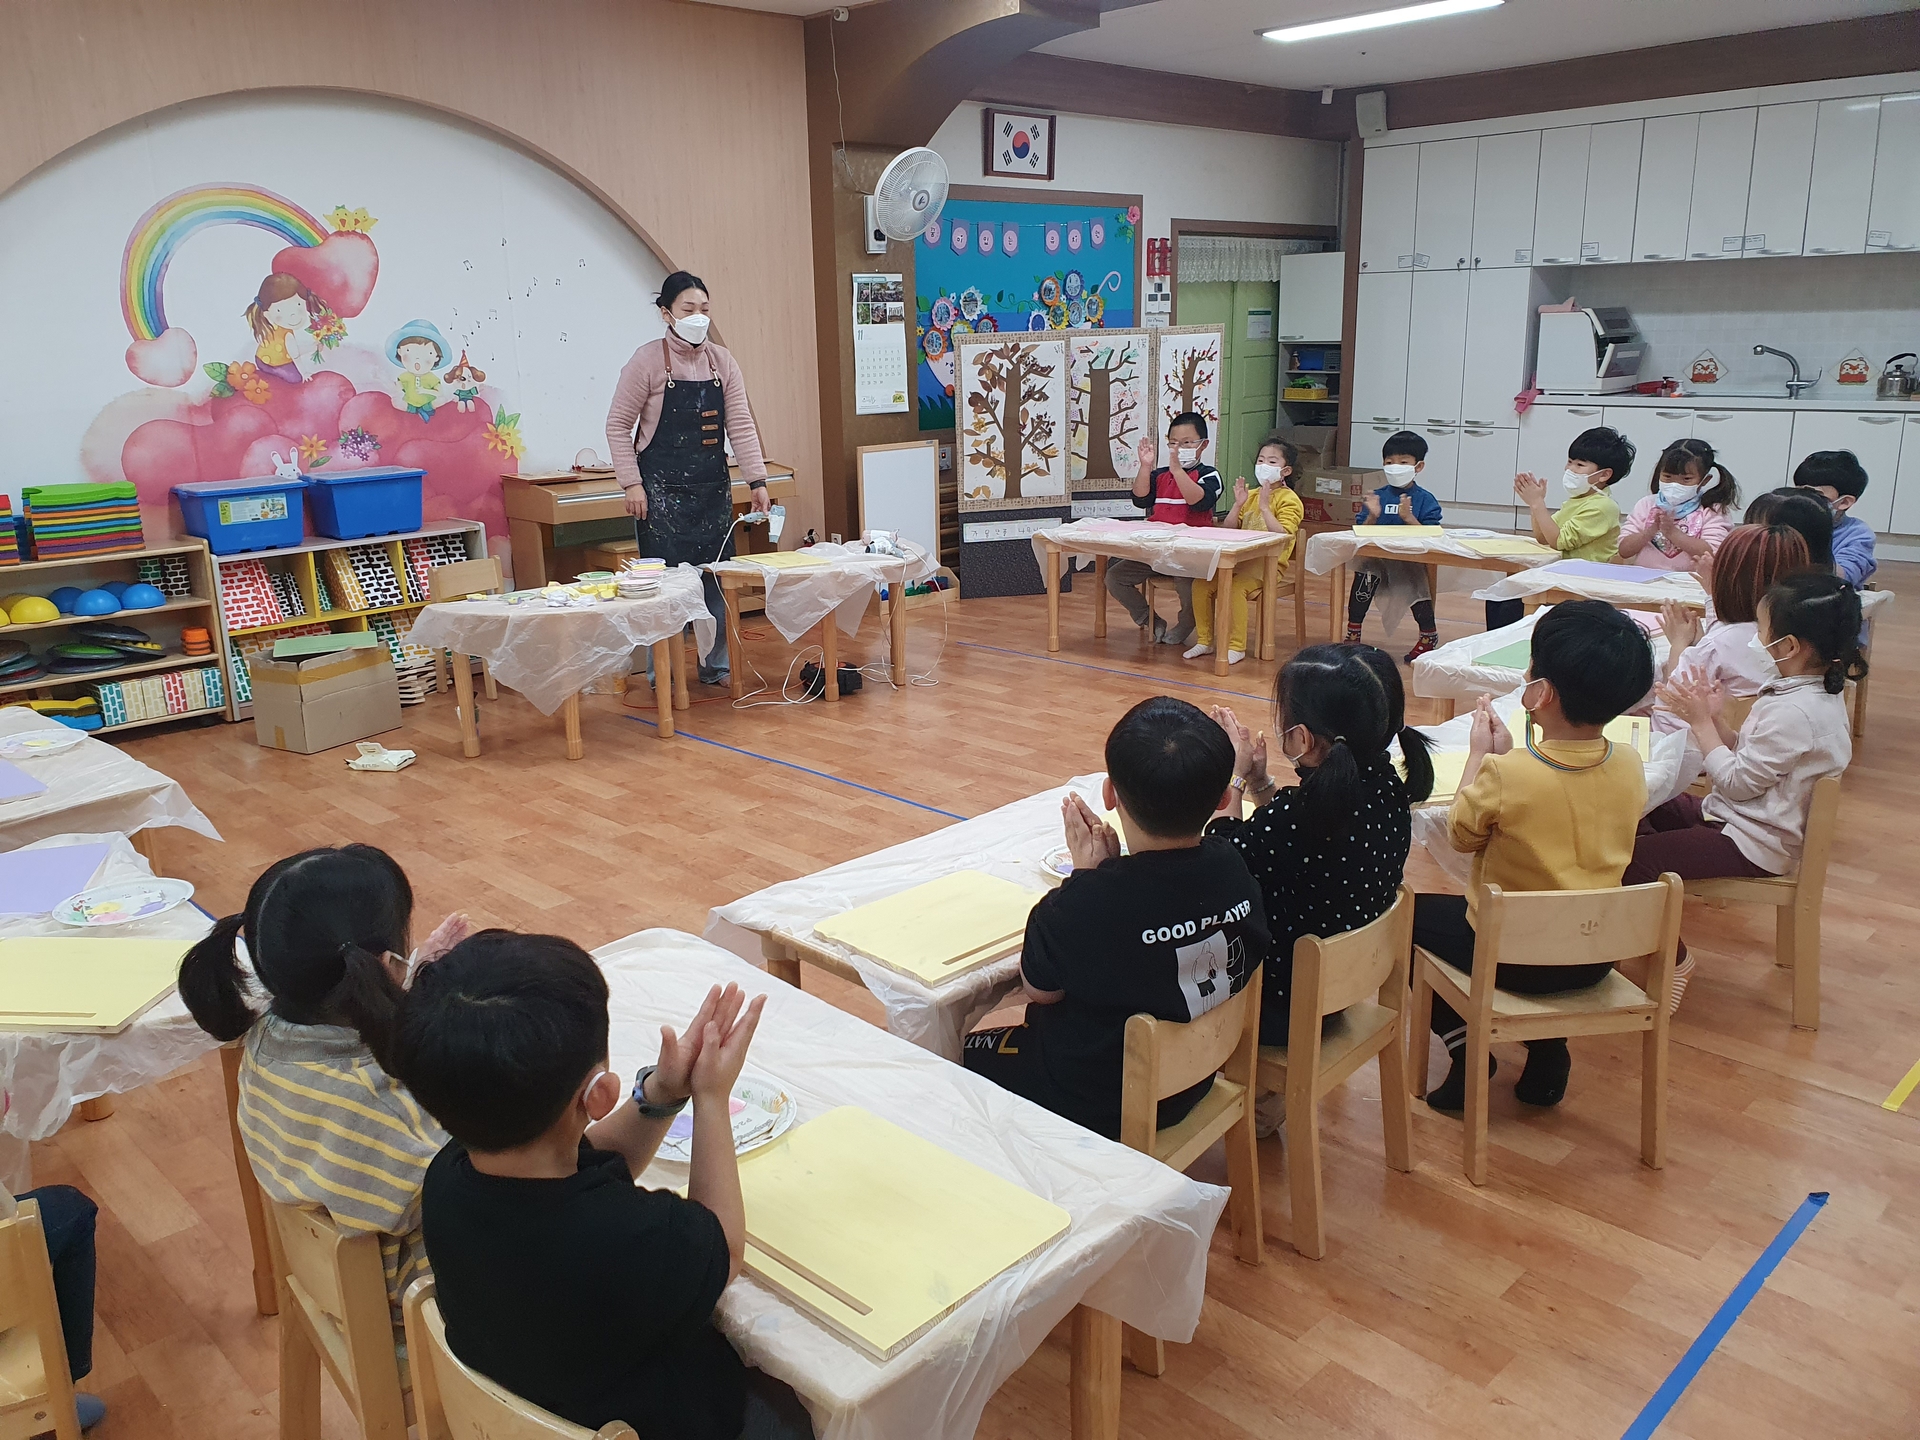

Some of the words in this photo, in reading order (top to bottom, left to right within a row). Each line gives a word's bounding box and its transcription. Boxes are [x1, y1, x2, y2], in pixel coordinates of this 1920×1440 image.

[858, 330, 864, 340] 11
[1386, 505, 1398, 514] TI
[1141, 920, 1197, 945] GOOD
[1200, 899, 1252, 930] PLAYER
